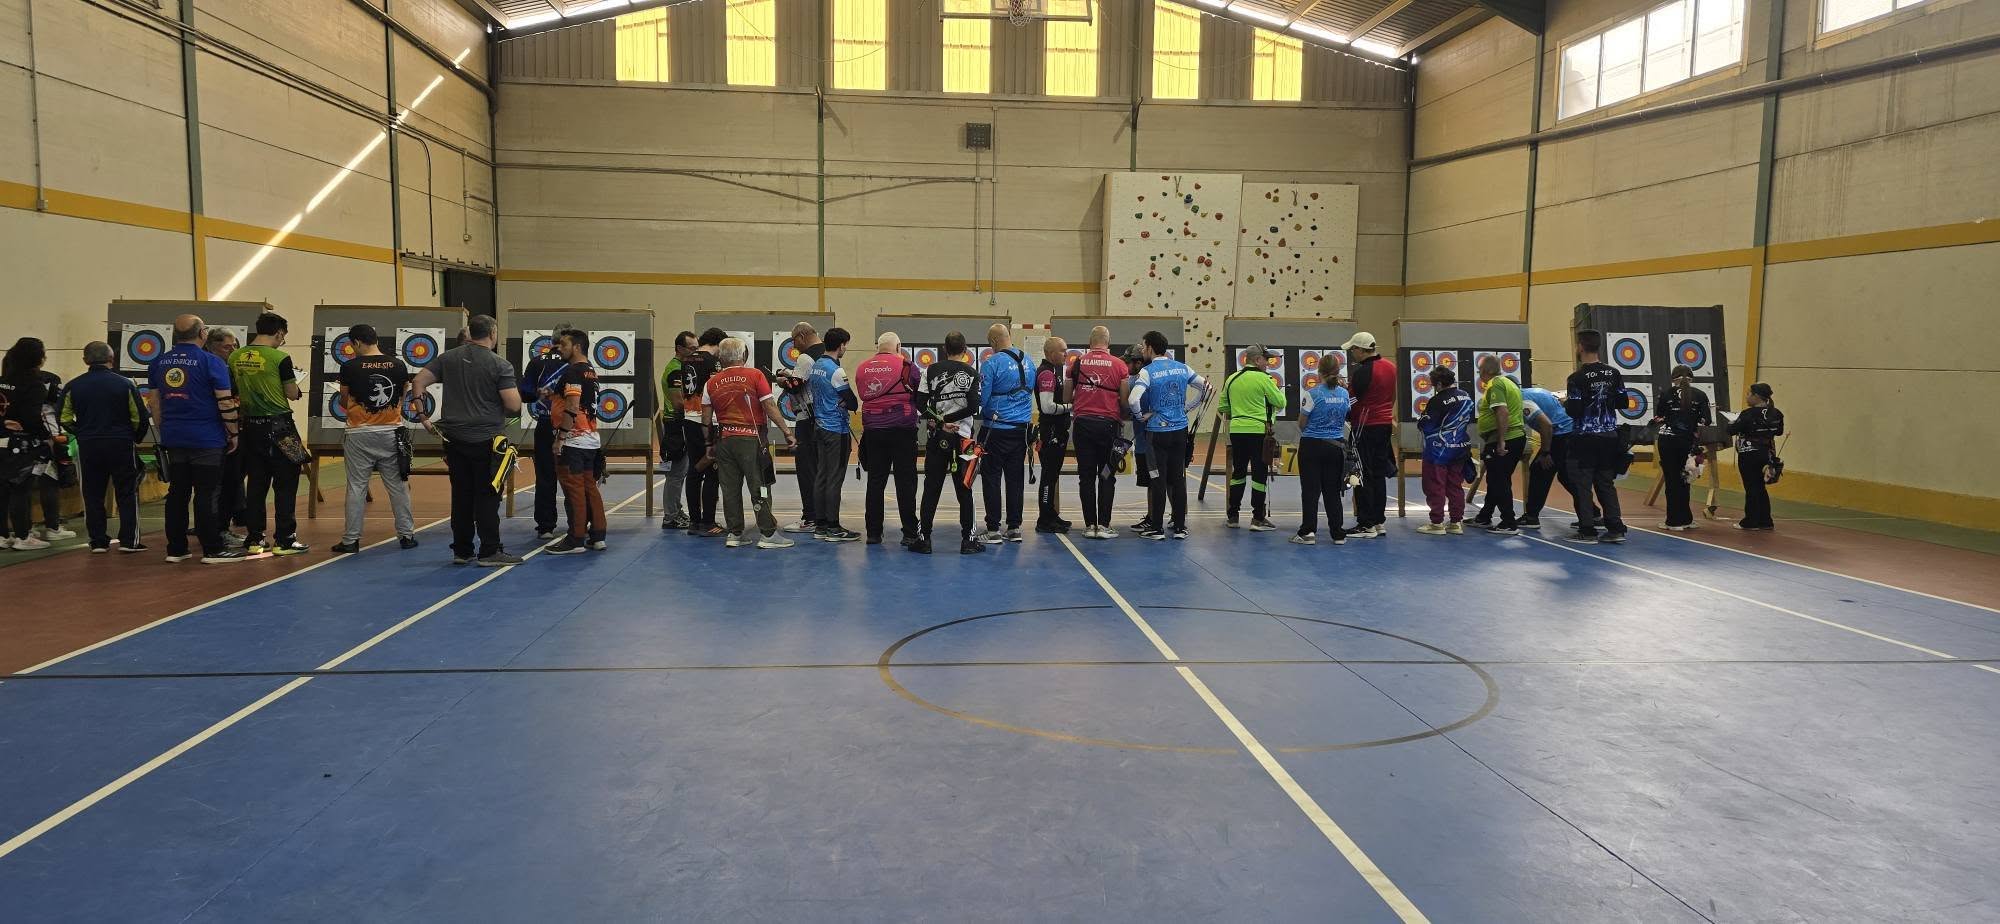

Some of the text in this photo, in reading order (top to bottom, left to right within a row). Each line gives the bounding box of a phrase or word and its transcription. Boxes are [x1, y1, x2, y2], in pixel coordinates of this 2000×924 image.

[361, 361, 395, 369] ERNESTO
[720, 375, 747, 385] PULIDO
[1286, 447, 1299, 473] 7
